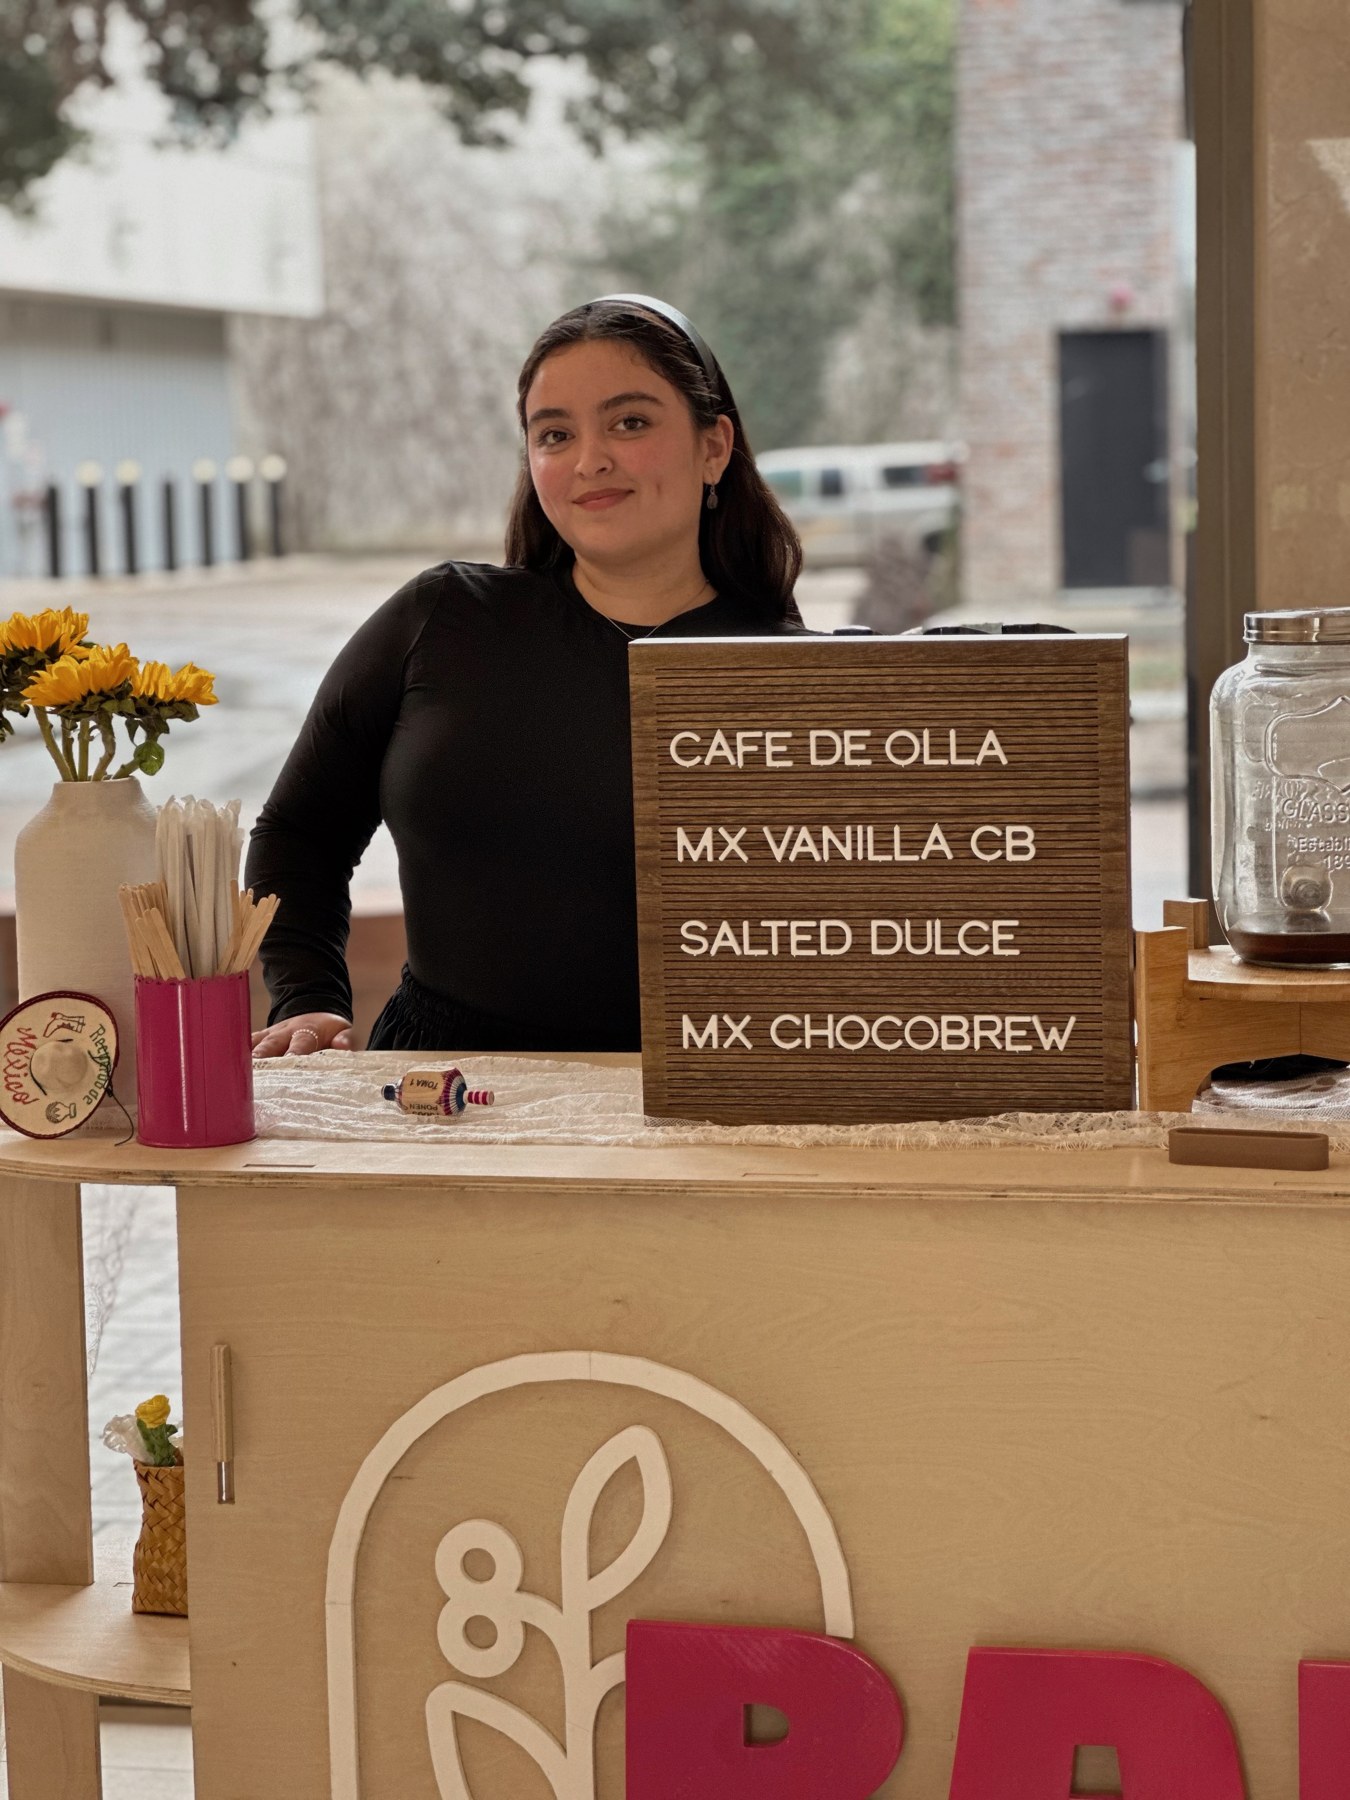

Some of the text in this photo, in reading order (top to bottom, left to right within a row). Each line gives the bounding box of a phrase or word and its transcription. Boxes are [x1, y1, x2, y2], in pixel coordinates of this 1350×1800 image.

[670, 728, 1007, 768] CAFE DE OLLA
[677, 823, 1035, 862] MX VANILLA CB
[681, 919, 1019, 957] SALTED DULCE
[683, 1015, 1075, 1052] MX CHOCOBREW
[417, 1079, 438, 1090] TOMA
[409, 1103, 438, 1111] PONEN
